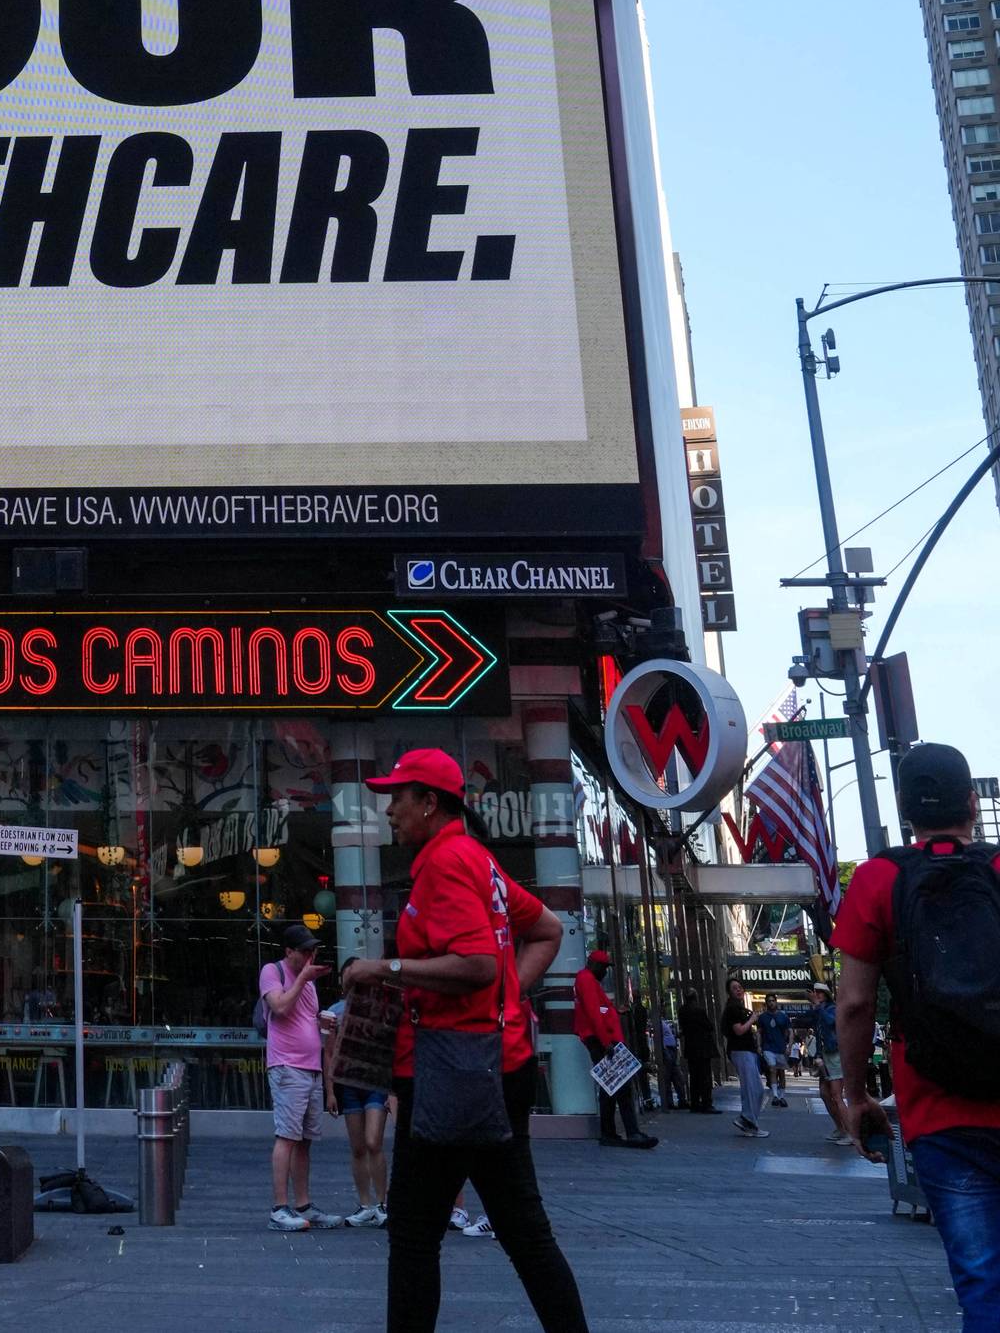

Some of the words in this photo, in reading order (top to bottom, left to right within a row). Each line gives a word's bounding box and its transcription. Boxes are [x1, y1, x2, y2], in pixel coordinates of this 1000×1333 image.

[682, 418, 711, 430] EDISON
[66, 496, 122, 525] USA.
[129, 494, 439, 524] WWW.OFTHEBRAVE.ORG
[82, 626, 376, 695] CAMINOS
[781, 720, 844, 739] Broadway
[38, 831, 56, 841] FLOW
[57, 833, 74, 842] ZONE
[14, 842, 39, 853] MOVING
[742, 969, 775, 981] HOTEL
[776, 969, 811, 981] EDISON
